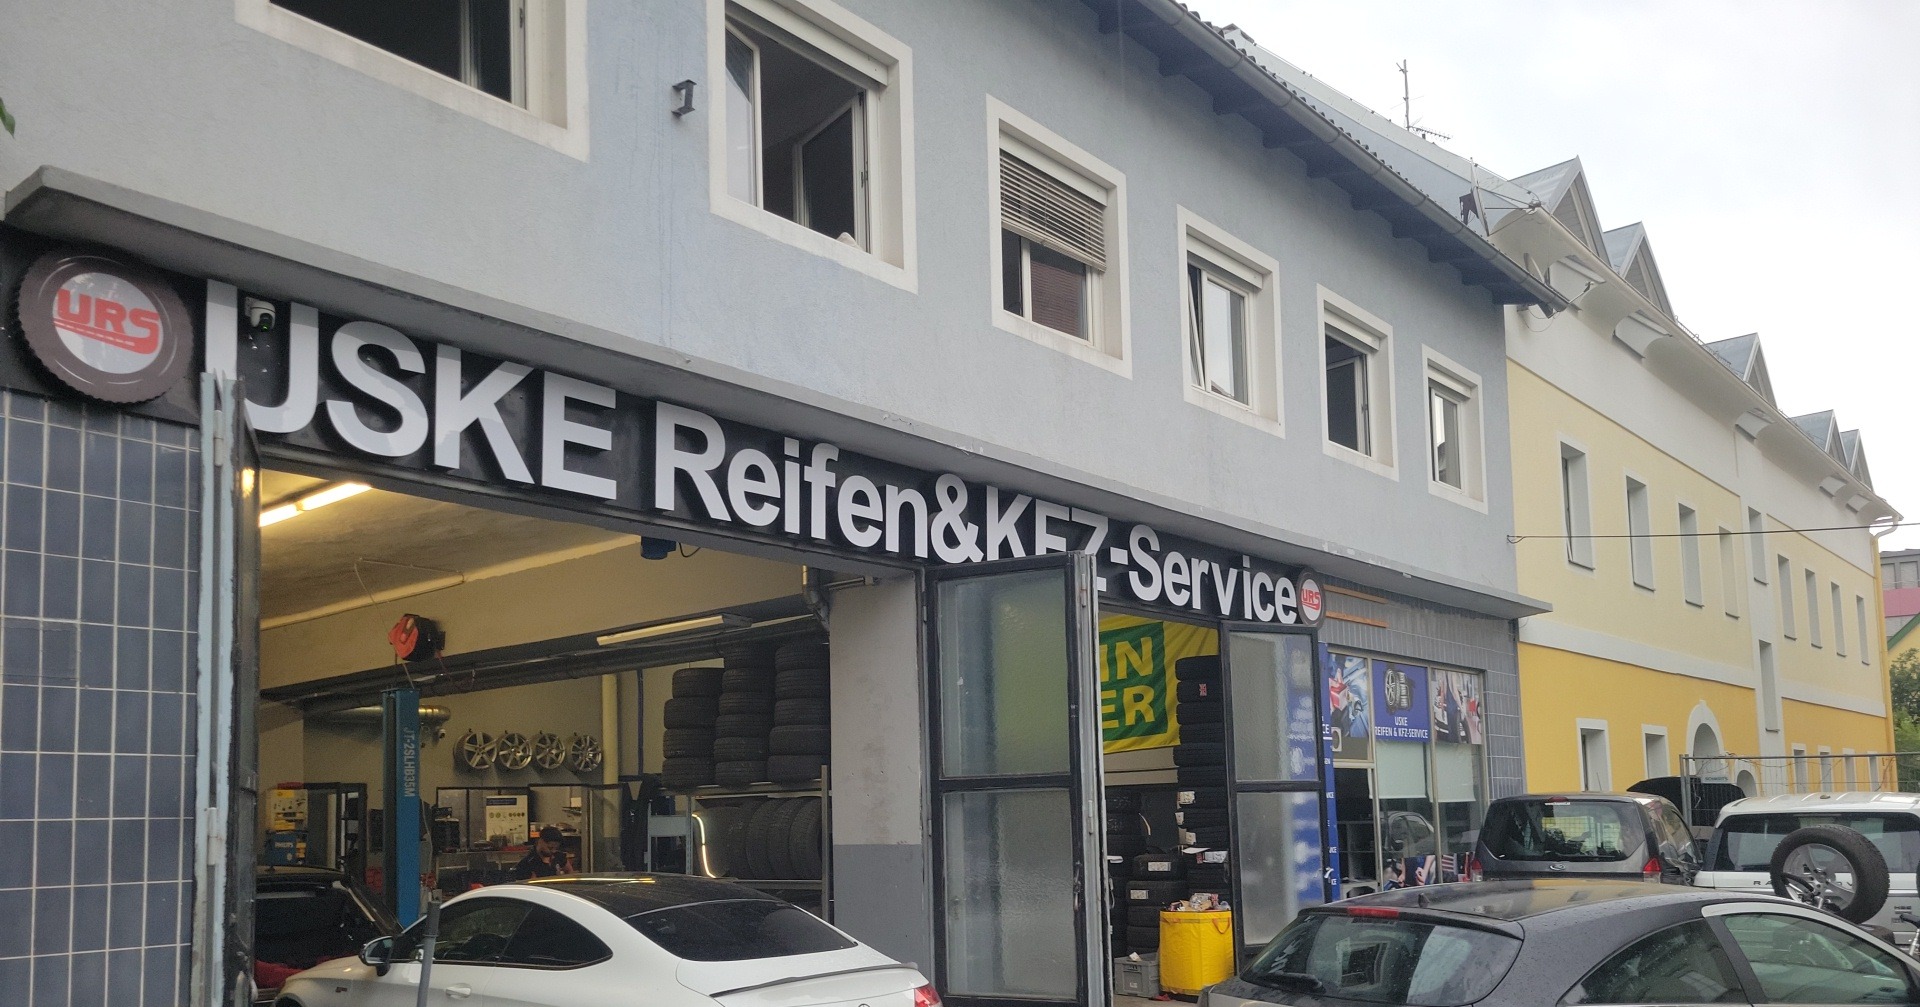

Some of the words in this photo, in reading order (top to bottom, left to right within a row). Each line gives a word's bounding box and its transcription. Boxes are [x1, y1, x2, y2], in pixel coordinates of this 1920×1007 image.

[56, 288, 161, 355] URS
[205, 279, 618, 500] USKE
[1301, 588, 1321, 611] URS
[1374, 726, 1393, 737] REIFEN
[1398, 729, 1429, 739] KFZ-SERVICE
[1394, 717, 1408, 727] USKE
